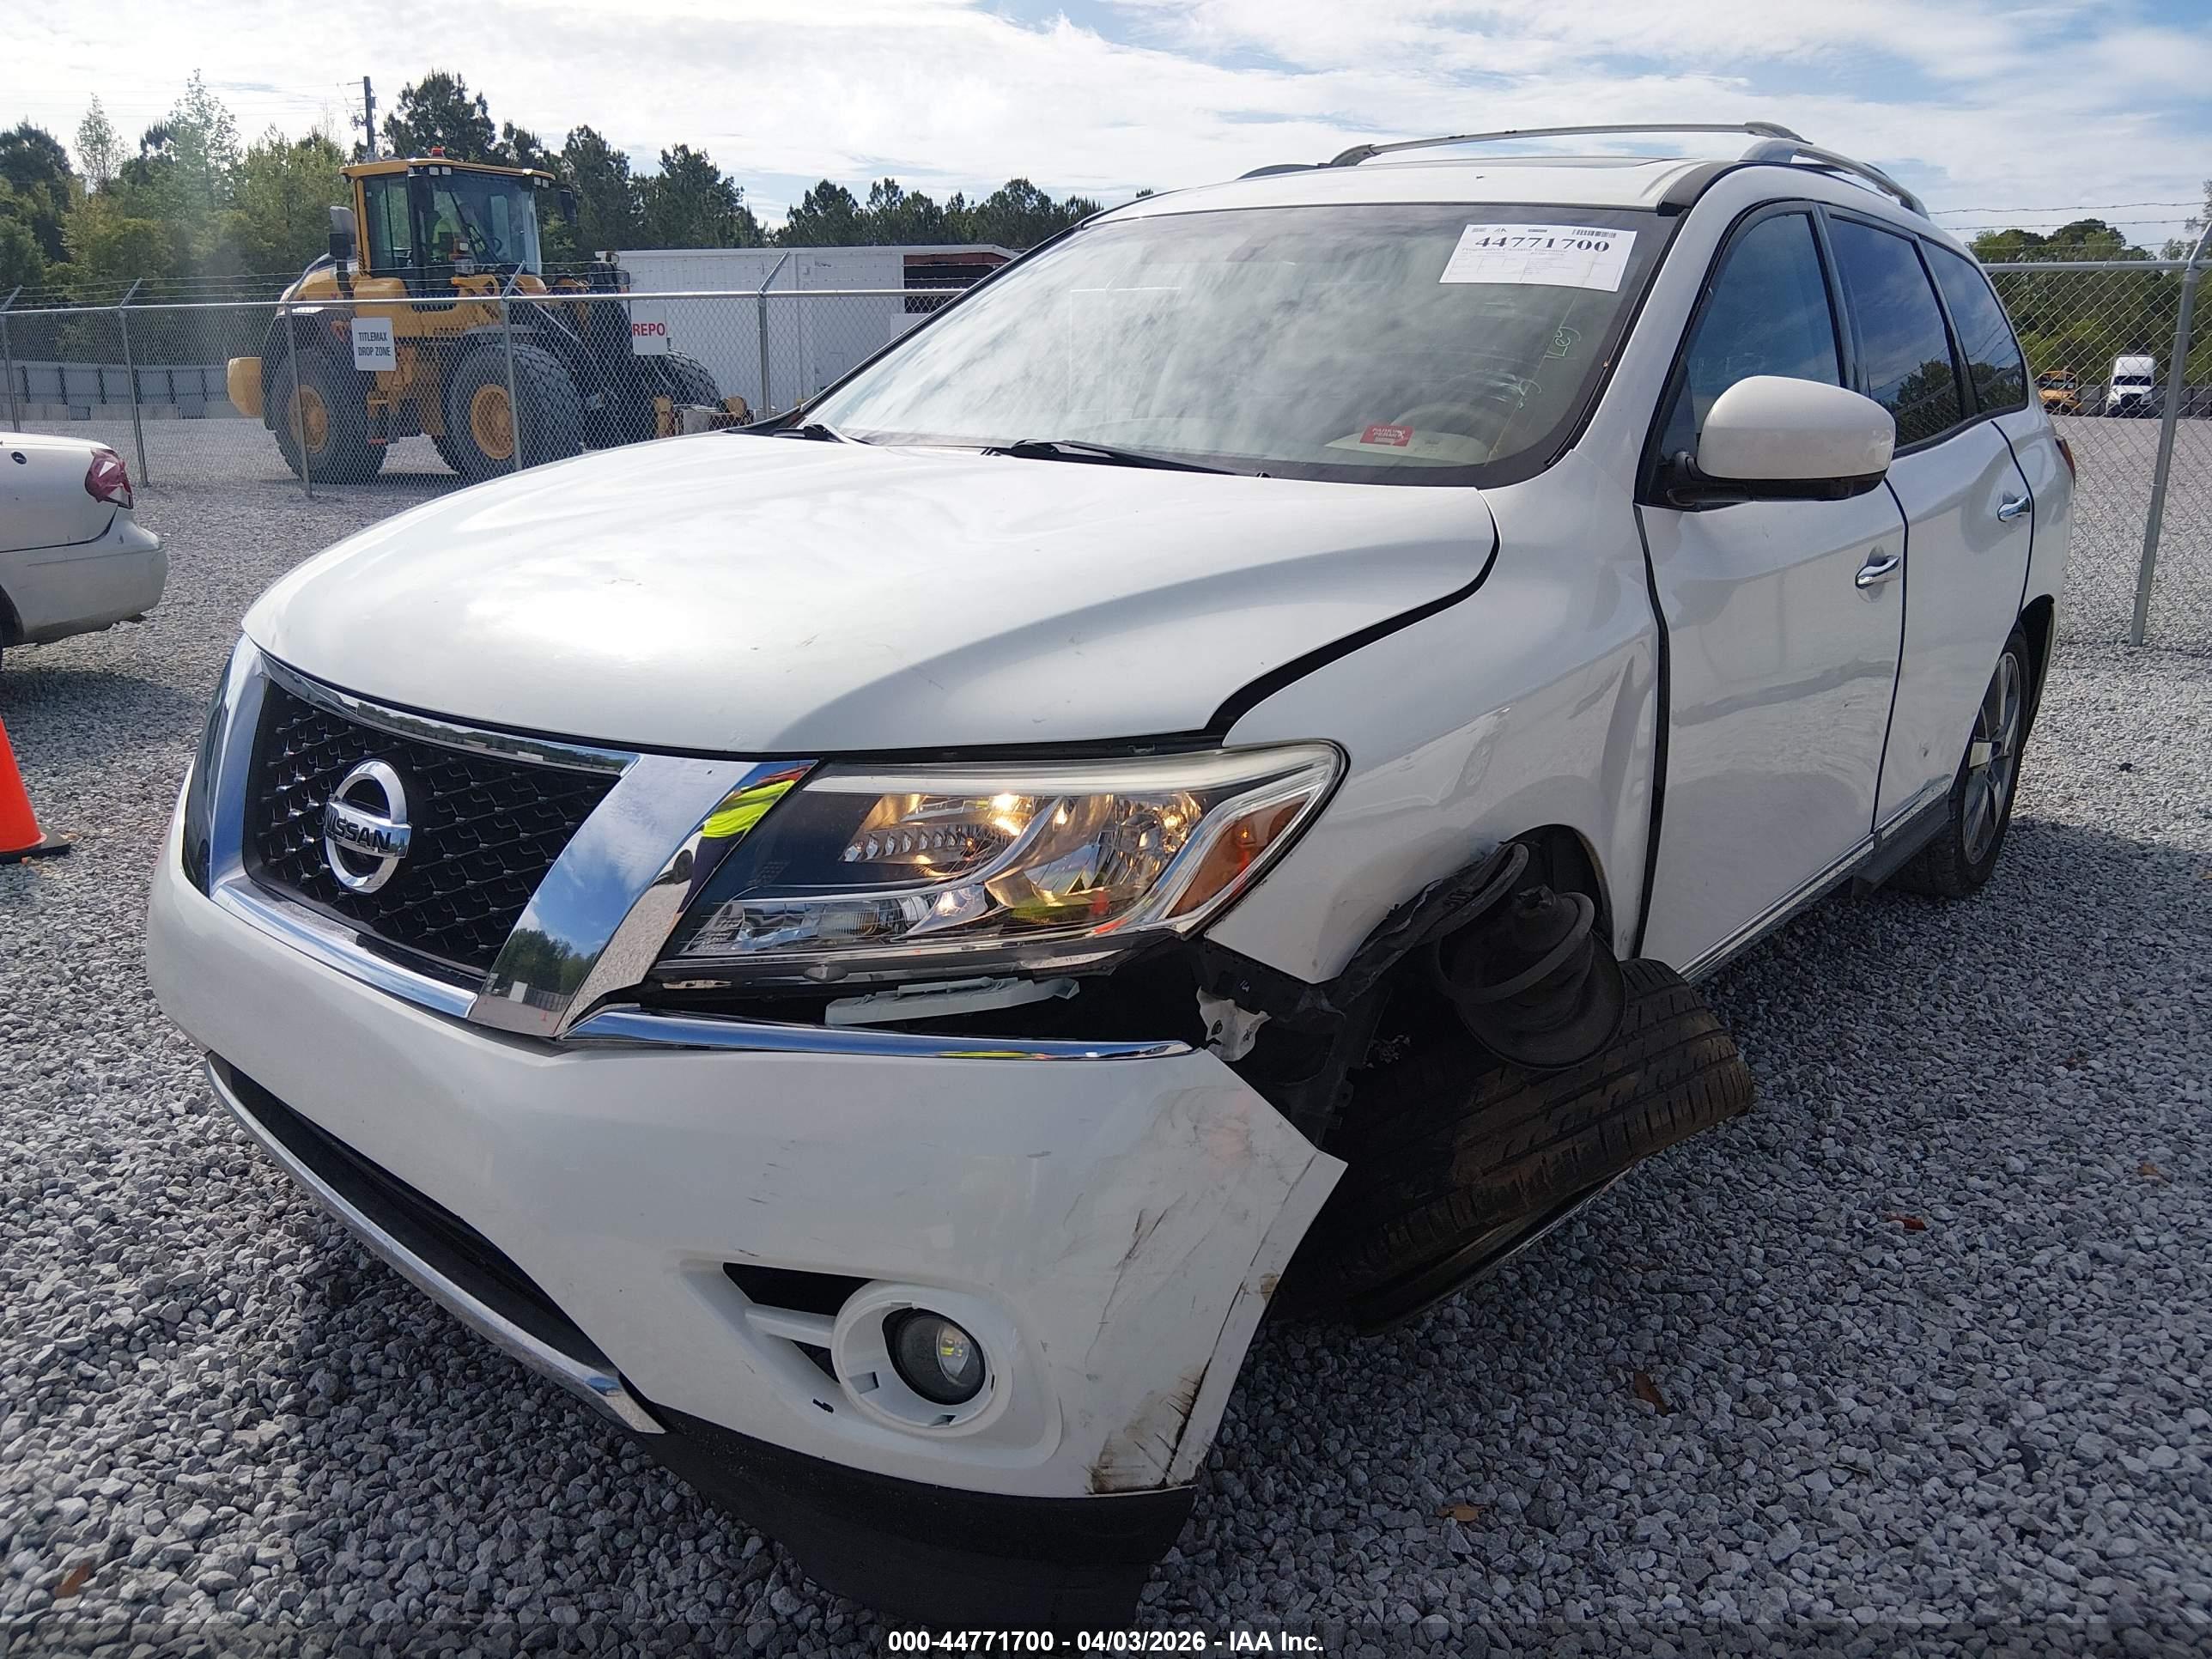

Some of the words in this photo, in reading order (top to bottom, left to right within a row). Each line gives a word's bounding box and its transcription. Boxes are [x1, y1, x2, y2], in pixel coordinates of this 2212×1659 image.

[1474, 236, 1610, 252] 44771700
[358, 331, 388, 342] TITLEMAX
[632, 323, 665, 337] REPO
[357, 346, 374, 356] DROP
[374, 346, 392, 356] ZONE
[325, 807, 392, 854] NISSAN
